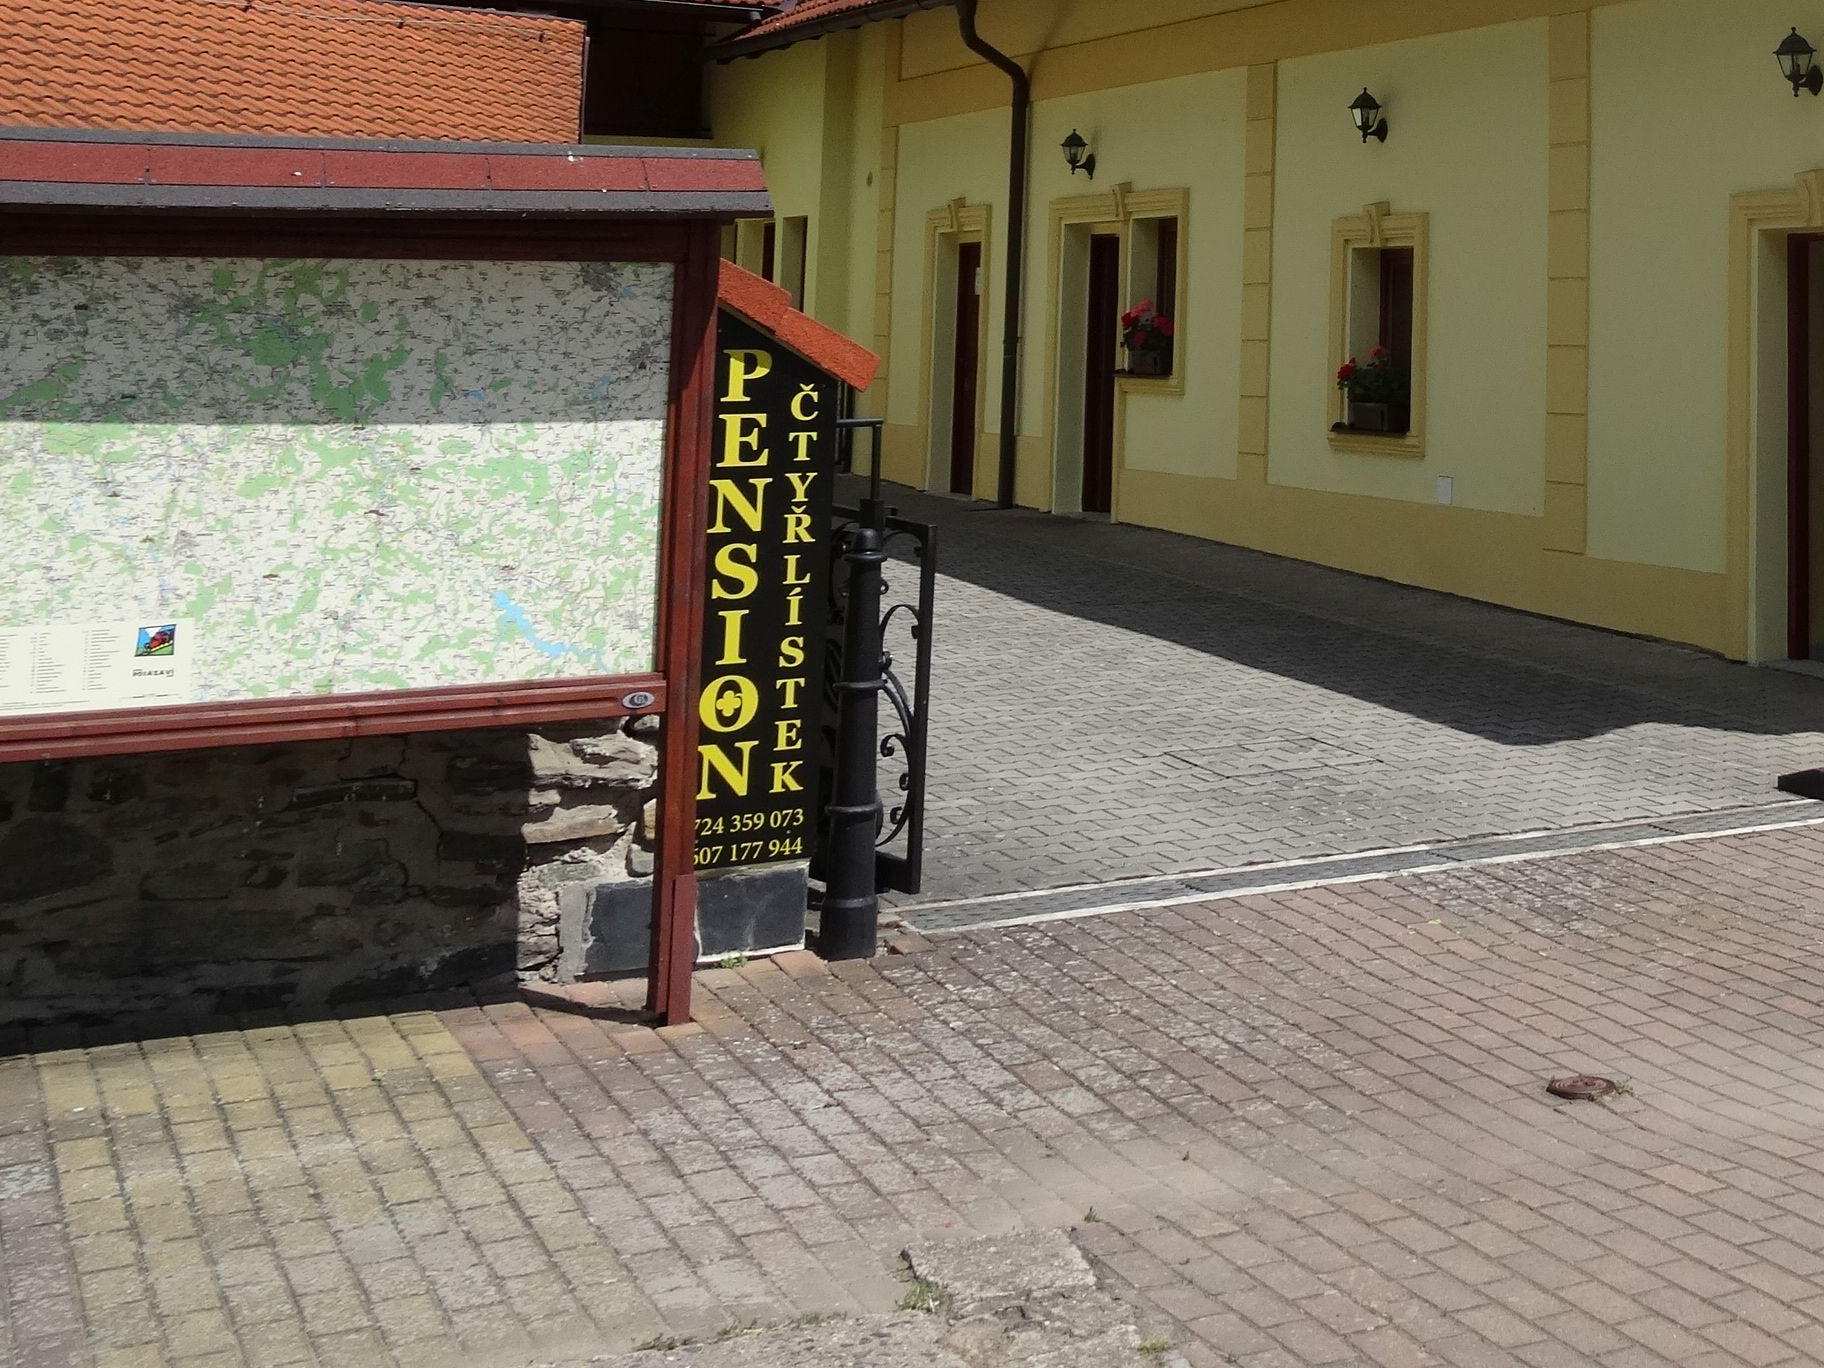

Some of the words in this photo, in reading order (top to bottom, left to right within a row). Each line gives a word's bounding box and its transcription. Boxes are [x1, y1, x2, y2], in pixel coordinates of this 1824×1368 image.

[696, 349, 772, 800] PENSION
[769, 383, 819, 793] ČTYŘLÍSTEK
[729, 841, 764, 862] 177
[768, 836, 803, 858] 944
[730, 813, 765, 833] 359
[769, 808, 804, 829] 073
